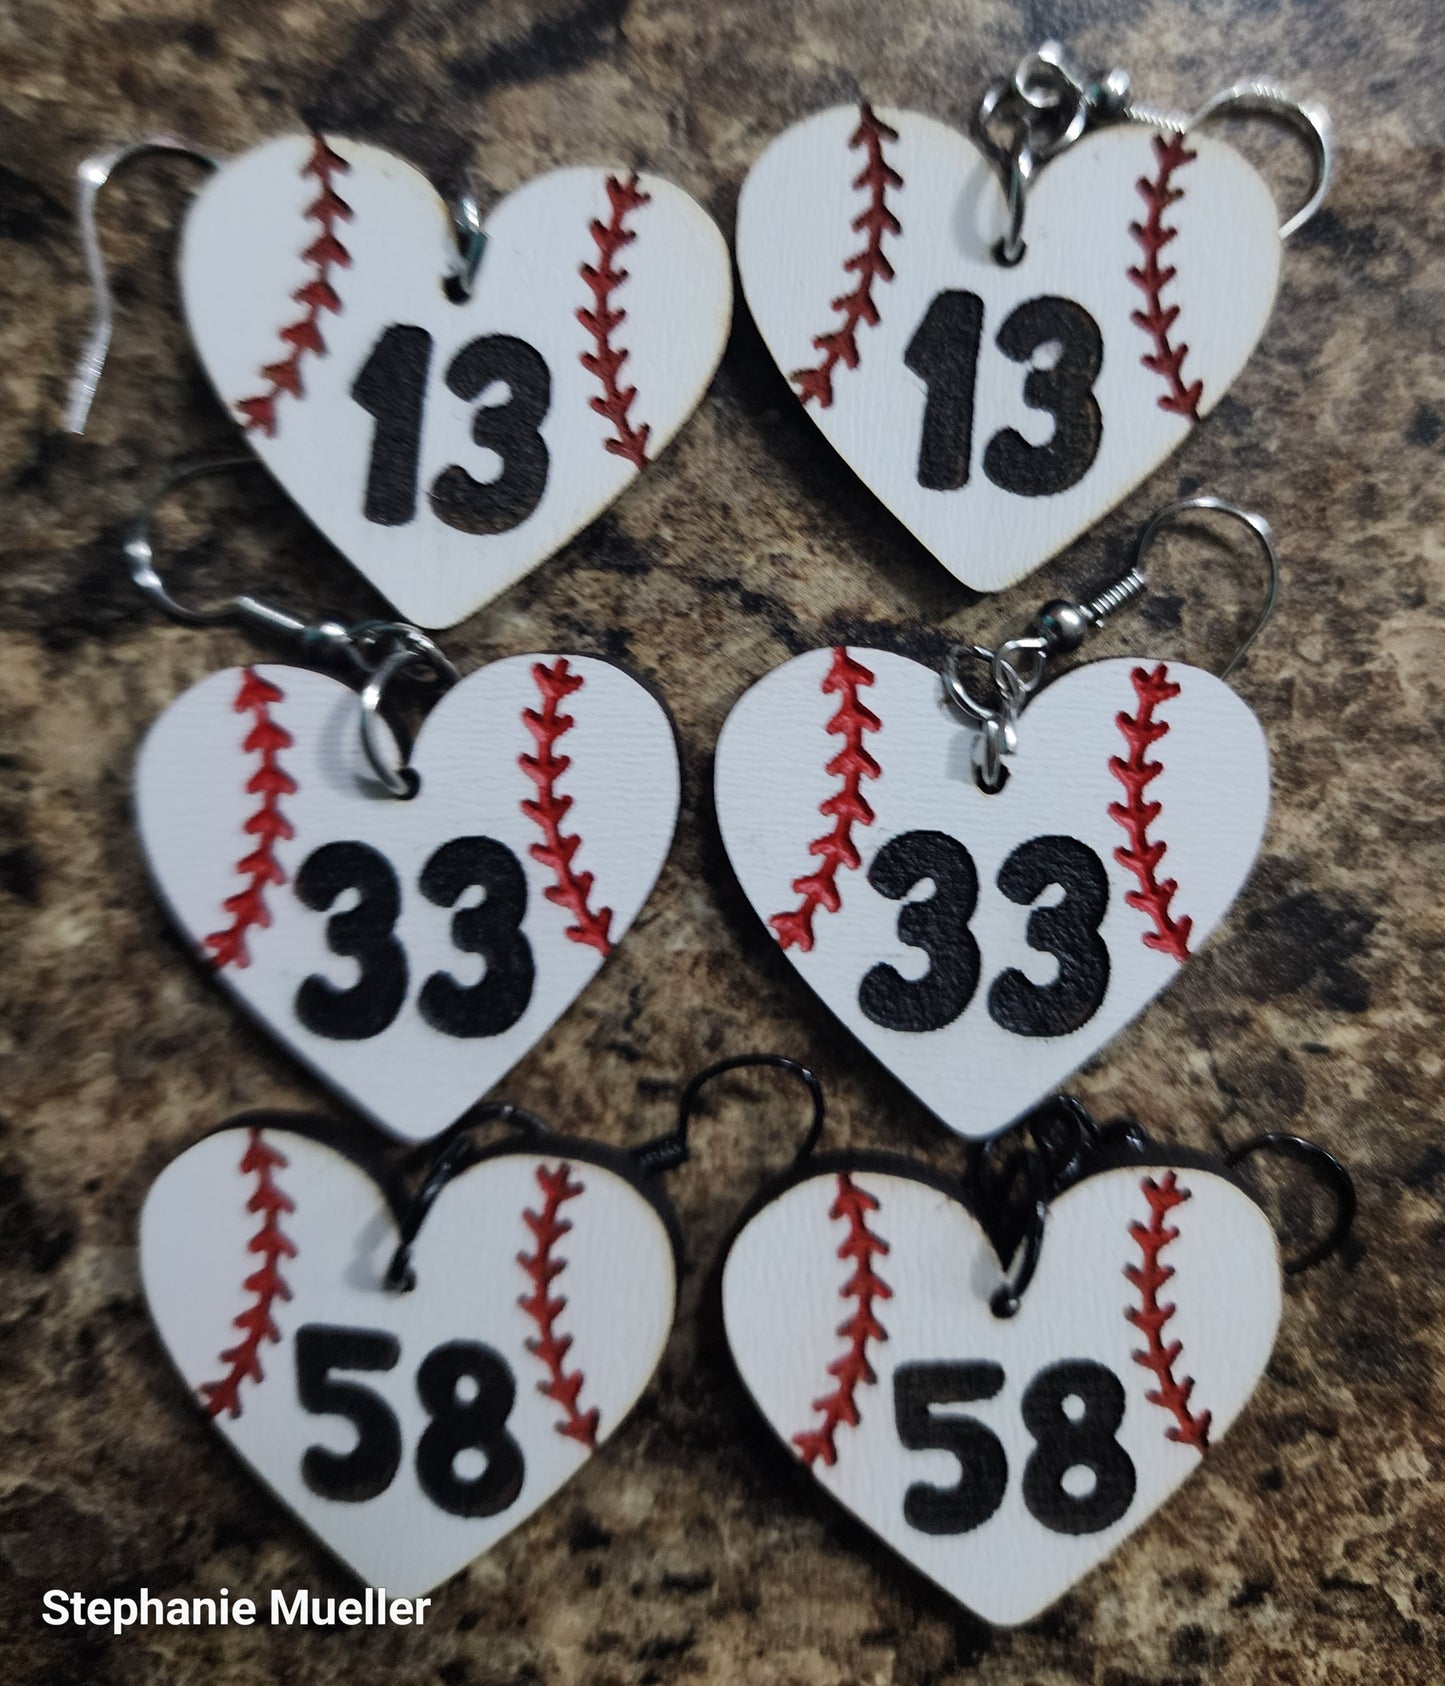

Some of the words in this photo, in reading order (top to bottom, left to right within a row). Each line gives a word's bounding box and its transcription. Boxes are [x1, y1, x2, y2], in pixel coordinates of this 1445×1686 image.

[350, 323, 552, 536] 13
[903, 288, 1105, 498] 13
[293, 835, 537, 1041] 33
[857, 829, 1112, 1038] 33
[294, 1323, 526, 1520] 58
[892, 1359, 1137, 1537] 58
